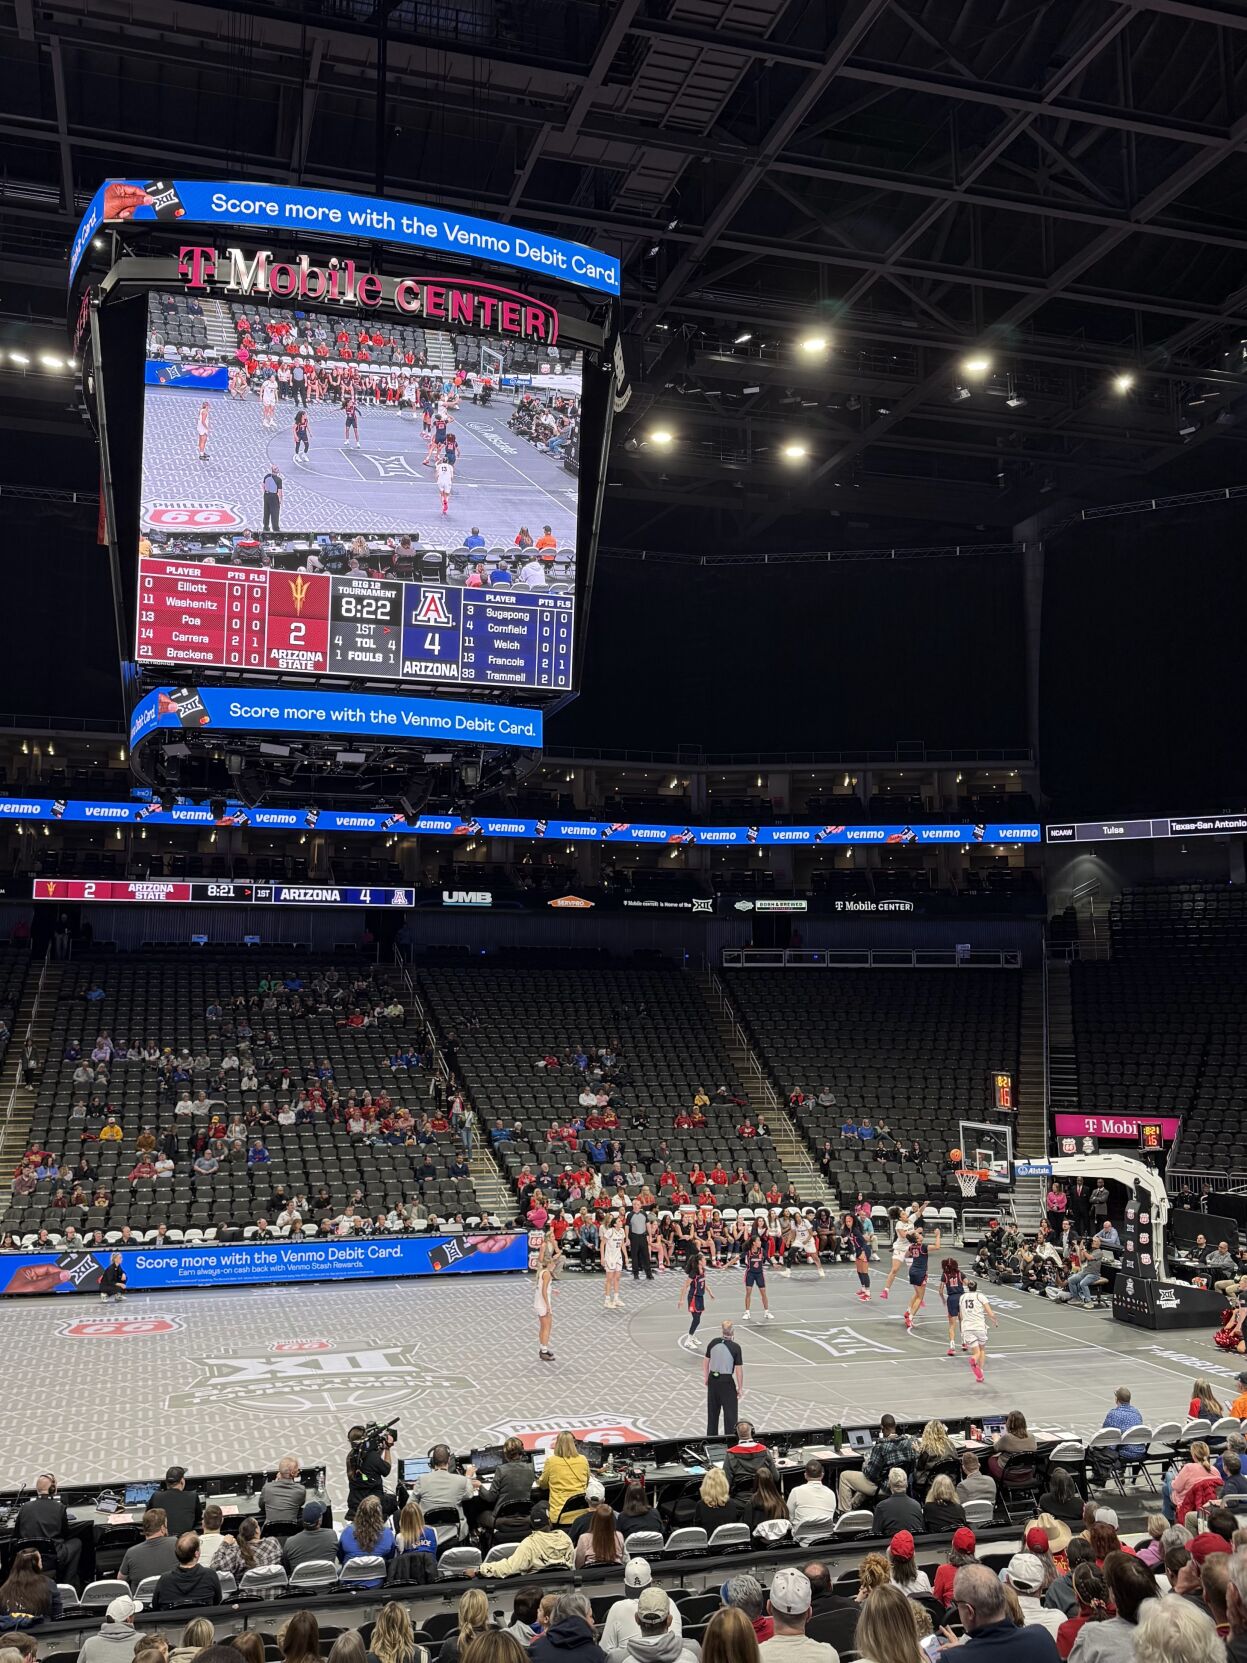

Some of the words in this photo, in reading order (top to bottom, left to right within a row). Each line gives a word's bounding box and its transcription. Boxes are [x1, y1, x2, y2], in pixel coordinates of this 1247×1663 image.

[211, 193, 279, 216] Score
[285, 203, 342, 222] more
[347, 208, 395, 231] with
[401, 216, 438, 238] the
[443, 222, 510, 254] Venmo
[515, 239, 567, 269] Debit
[571, 255, 619, 286] Card.
[178, 246, 217, 290] T
[226, 248, 383, 309] Mobile
[395, 280, 547, 341] CENTER
[160, 511, 222, 523] 66
[166, 566, 201, 577] PLAYER
[227, 571, 245, 580] PTS
[249, 573, 266, 581] FLS
[145, 577, 153, 588] 0
[177, 581, 207, 593] Elliott
[233, 586, 241, 596] 0
[253, 587, 261, 597] 0
[352, 580, 369, 588] BIG
[370, 581, 381, 589] 12
[338, 587, 397, 598] TOURNAMENT
[143, 593, 154, 604] 11
[232, 601, 240, 612] 0
[252, 603, 260, 613] 0
[485, 594, 516, 604] PLAYER
[538, 598, 554, 607] PTS
[557, 600, 572, 608] FLS
[341, 597, 391, 620] 8:22
[466, 605, 474, 615] 3
[486, 608, 530, 621] Sugapong
[543, 612, 551, 622] 0
[560, 613, 568, 623] 0
[141, 611, 155, 621] 13
[182, 614, 201, 626] Poa
[232, 619, 240, 629] 0
[252, 620, 260, 631] 0
[289, 622, 306, 646] 2
[355, 624, 376, 635] 1ST
[466, 620, 474, 630] 4
[487, 623, 528, 635] Cornfield
[542, 627, 550, 637] 0
[559, 628, 567, 638] 0
[140, 628, 153, 639] 14
[172, 631, 209, 643] Carrera
[231, 635, 239, 646] 2
[252, 637, 259, 647] 1
[334, 635, 343, 646] 4
[355, 637, 376, 649] TOL
[388, 640, 396, 651] 4
[424, 632, 441, 656] 4
[464, 637, 475, 647] 11
[493, 639, 520, 650] Welch
[542, 643, 550, 653] 0
[559, 644, 566, 654] 0
[140, 645, 153, 656] 21
[166, 647, 214, 660] Brackens
[231, 652, 239, 662] 0
[251, 653, 259, 664] 0
[270, 648, 323, 662] ARIZONA
[335, 649, 342, 660] 1
[348, 650, 383, 663] FOULS
[388, 653, 395, 664] 1
[463, 652, 475, 663] 13
[541, 658, 549, 668] 2
[559, 660, 565, 670] 1
[278, 658, 315, 670] STATE
[403, 661, 458, 677] ARIZONA
[462, 669, 475, 679] 33
[485, 670, 526, 682] Trammell
[541, 674, 549, 684] 2
[558, 676, 565, 685] 0
[229, 702, 281, 719] Score
[284, 707, 326, 721] more
[330, 707, 366, 722] with
[369, 709, 397, 725] the
[401, 710, 452, 728] Venmo
[455, 715, 495, 732] Debit
[498, 719, 536, 737] Card.
[0, 802, 41, 814] venmo
[85, 806, 130, 817] venmo
[172, 809, 214, 821] venmo
[255, 813, 297, 824] venmo
[335, 816, 376, 827] venmo
[488, 822, 526, 833] venmo
[560, 825, 597, 836] venmo
[631, 828, 667, 839] venmo
[922, 828, 961, 838] venmo
[998, 827, 1039, 838] venmo
[1050, 828, 1073, 837] NCAAW
[1102, 826, 1124, 835] Tulsa
[1171, 821, 1213, 832] Texas-San
[700, 831, 737, 841] venmo
[772, 830, 810, 840] venmo
[846, 829, 885, 839] venmo
[84, 883, 96, 898] 2
[128, 883, 174, 893] ARIZONA
[207, 884, 235, 897] 8:21
[257, 889, 271, 898] 1ST
[280, 888, 341, 901] ARIZONA
[135, 891, 166, 900] STATE
[359, 889, 371, 904] 4
[442, 890, 493, 904] UMB
[834, 900, 844, 911] T
[845, 900, 877, 911] Mobile
[877, 902, 912, 911] CENTER
[1000, 1087, 1010, 1107] 16
[1084, 1118, 1098, 1133] T
[1101, 1119, 1140, 1135] Mobi
[1148, 1135, 1158, 1146] 16
[531, 1237, 542, 1245] 66
[136, 1256, 178, 1269] Score
[181, 1256, 217, 1267] more
[220, 1252, 251, 1266] with
[253, 1251, 278, 1264] the
[281, 1249, 325, 1263] Venmo
[328, 1246, 365, 1261] Debit
[367, 1244, 404, 1258] Card.
[178, 1268, 196, 1276] Earn
[197, 1267, 233, 1277] always-on
[233, 1266, 251, 1274] cash
[251, 1265, 269, 1273] back
[270, 1264, 287, 1272] with
[287, 1263, 311, 1271] Venmo
[312, 1261, 333, 1269] Stash
[333, 1260, 364, 1269] Rewards.
[965, 1299, 974, 1309] 13
[82, 1322, 159, 1334] 66
[184, 1381, 457, 1403] TOURNAMENT
[194, 1376, 442, 1397] BASKETBALL
[510, 1417, 622, 1432] PHILLIPS
